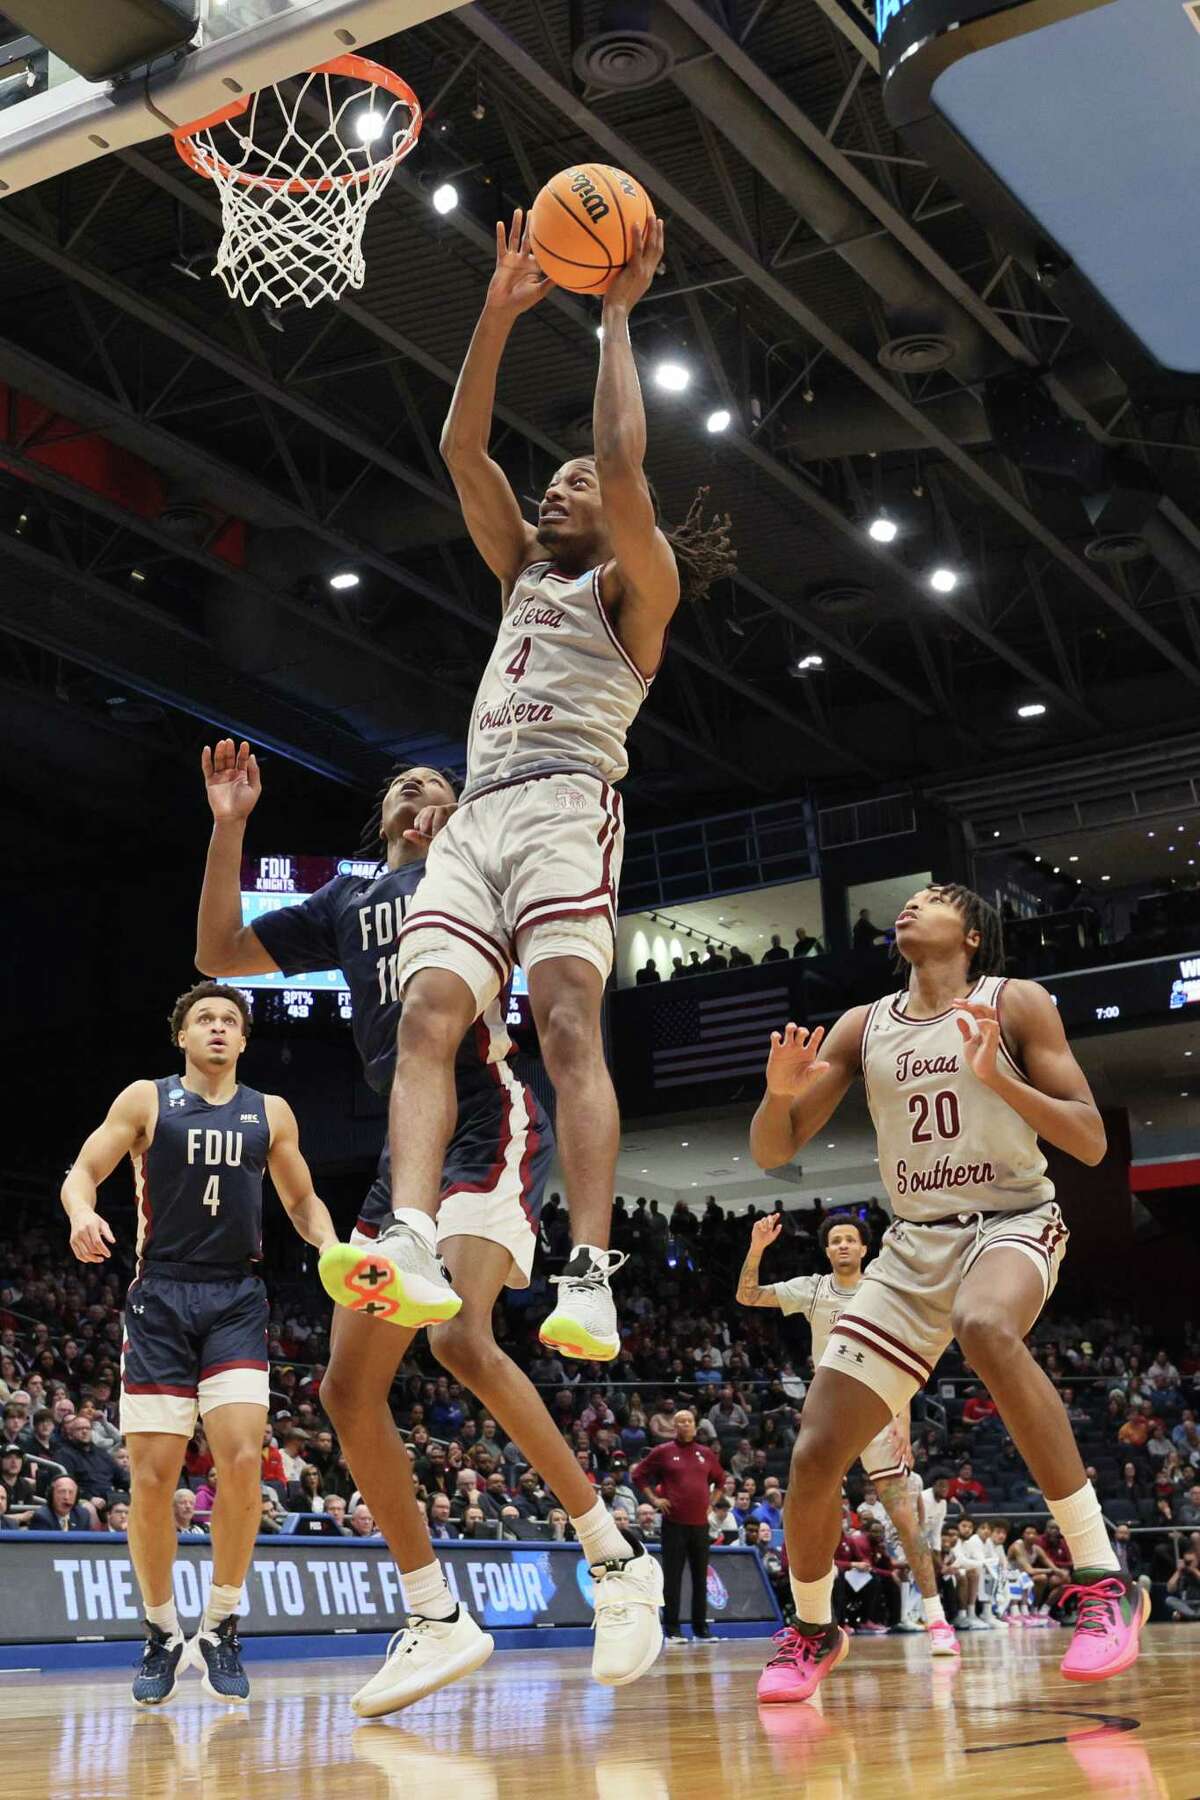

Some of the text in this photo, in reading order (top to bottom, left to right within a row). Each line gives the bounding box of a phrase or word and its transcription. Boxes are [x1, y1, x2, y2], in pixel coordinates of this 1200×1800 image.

[512, 596, 565, 628] Texas
[505, 637, 531, 683] 4
[256, 878, 295, 891] KNIGHTS
[260, 858, 290, 878] FDU
[376, 953, 400, 1004] 11
[283, 991, 314, 1005] 3PT%
[287, 1005, 309, 1018] 43
[1095, 1005, 1120, 1019] 7:00
[896, 1050, 959, 1082] Texas
[908, 1091, 961, 1143] 20
[187, 1129, 243, 1167] FDU
[897, 1155, 994, 1194] Southern
[202, 1175, 220, 1216] 4
[53, 1560, 138, 1620] THE
[254, 1561, 305, 1616] TO
[307, 1561, 376, 1615] THE
[467, 1562, 548, 1612] FOUR
